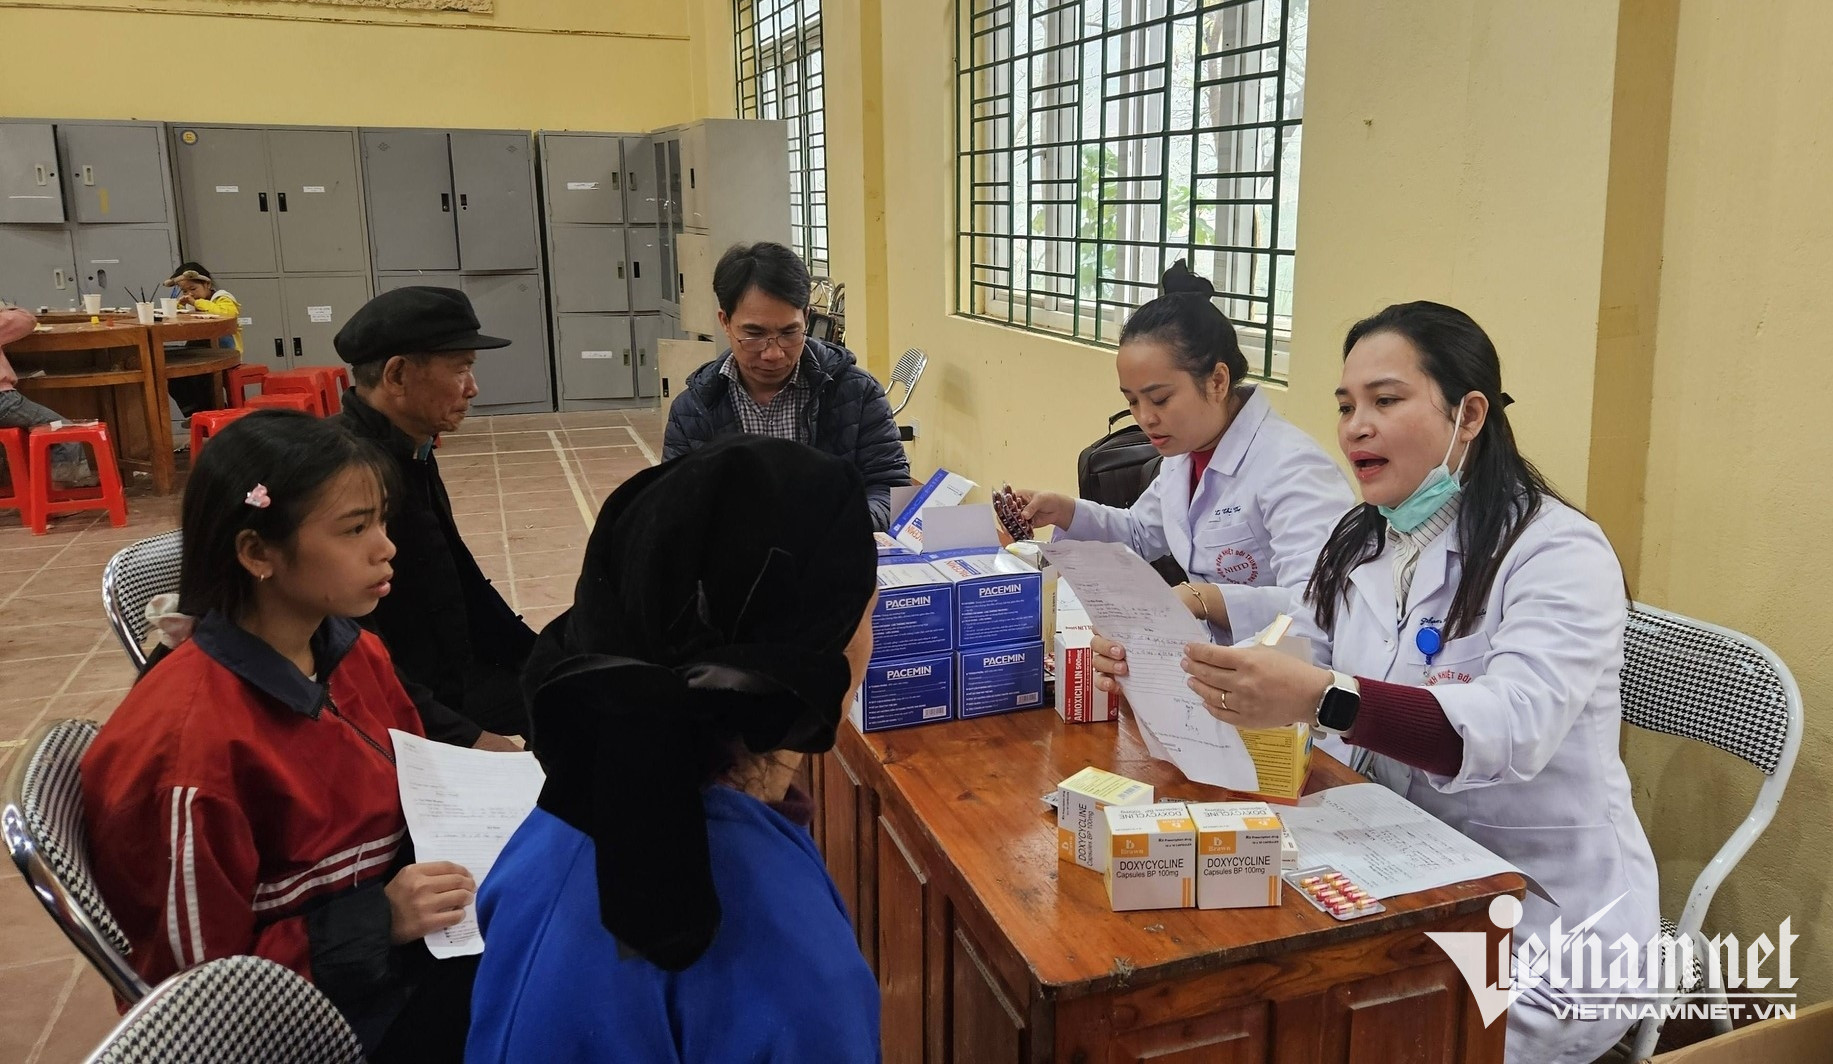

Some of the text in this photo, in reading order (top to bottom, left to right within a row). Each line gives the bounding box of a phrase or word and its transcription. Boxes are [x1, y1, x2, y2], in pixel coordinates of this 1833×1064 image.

[978, 584, 1022, 597] PACEMIN
[885, 595, 931, 609] PACEMIN
[983, 653, 1025, 667] PACEMIN
[886, 665, 932, 680] PACEMIN
[1074, 649, 1083, 721] AMOXICILLIN 500mg
[1120, 811, 1182, 819] DOXYCYCLINE
[1078, 802, 1087, 862] DOXYCYCLINE
[1087, 831, 1093, 840] BP
[1120, 859, 1184, 870] DOXYCYCLINE
[1207, 855, 1271, 867] DOXYCYCLINE
[1116, 870, 1145, 879] Capsules
[1203, 868, 1232, 876] Capsules
